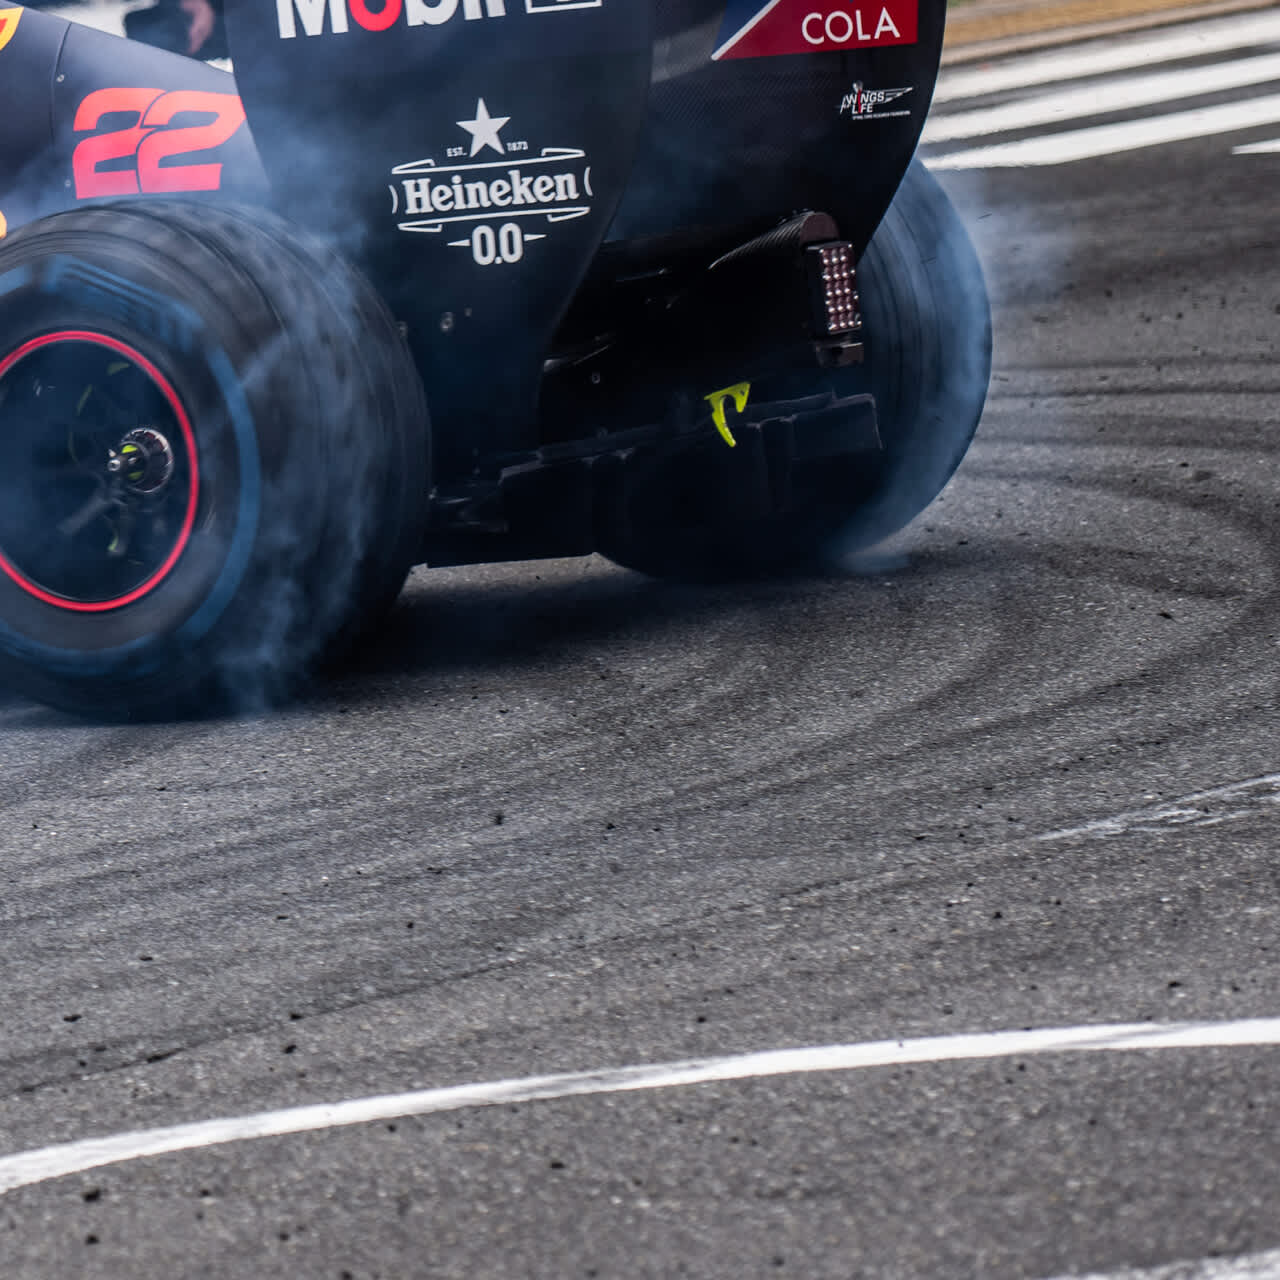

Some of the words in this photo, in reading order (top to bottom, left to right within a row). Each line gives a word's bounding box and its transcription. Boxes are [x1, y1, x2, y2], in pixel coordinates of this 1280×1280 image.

[801, 7, 901, 45] COLA
[72, 87, 247, 200] 22
[402, 169, 579, 215] Heineken
[471, 222, 524, 266] 0.0
